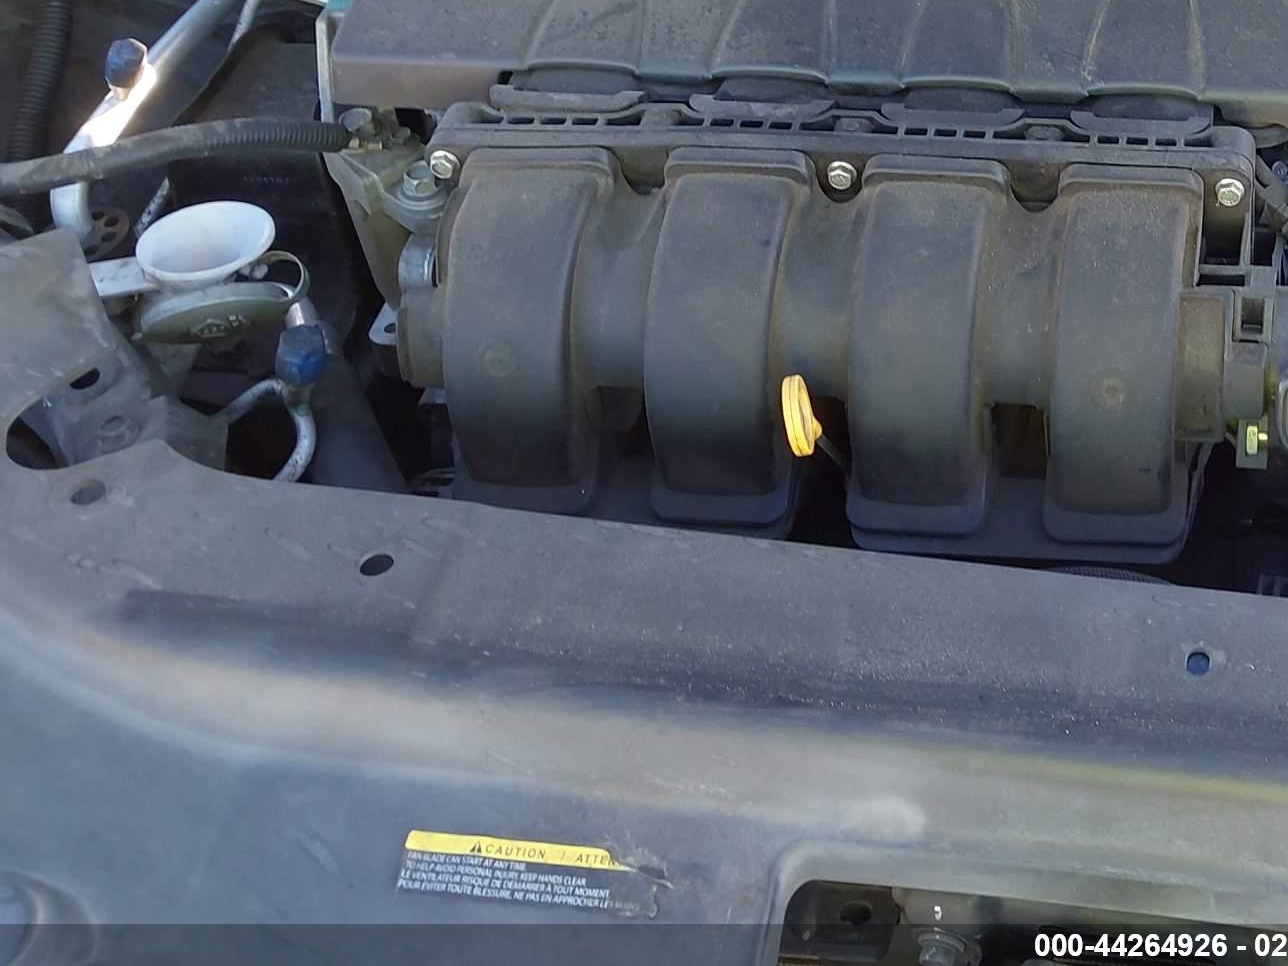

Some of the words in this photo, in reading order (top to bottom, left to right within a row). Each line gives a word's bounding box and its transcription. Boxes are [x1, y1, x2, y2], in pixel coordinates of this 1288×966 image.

[407, 851, 423, 860] FAN
[423, 853, 445, 863] BLADE
[446, 855, 461, 865] CAN
[462, 856, 483, 866] START
[483, 858, 494, 867] AT
[493, 859, 508, 869] ANY
[485, 843, 546, 860] CAUTION
[401, 869, 412, 879] LE
[412, 870, 461, 884] VENTILATEUR
[461, 875, 490, 887] RISQUE
[490, 878, 503, 888] DE
[552, 884, 573, 895] TOUT
[406, 860, 416, 870] TO
[416, 862, 434, 872] HELP
[434, 864, 457, 874] AVOID
[456, 865, 493, 878] PERSONAL
[519, 871, 538, 881] KEEP
[537, 873, 563, 884] HANDS
[397, 878, 421, 889] POUR
[447, 882, 472, 894] TOUTE
[513, 890, 525, 901] NE
[525, 891, 540, 903] PAS
[540, 893, 553, 904] EN
